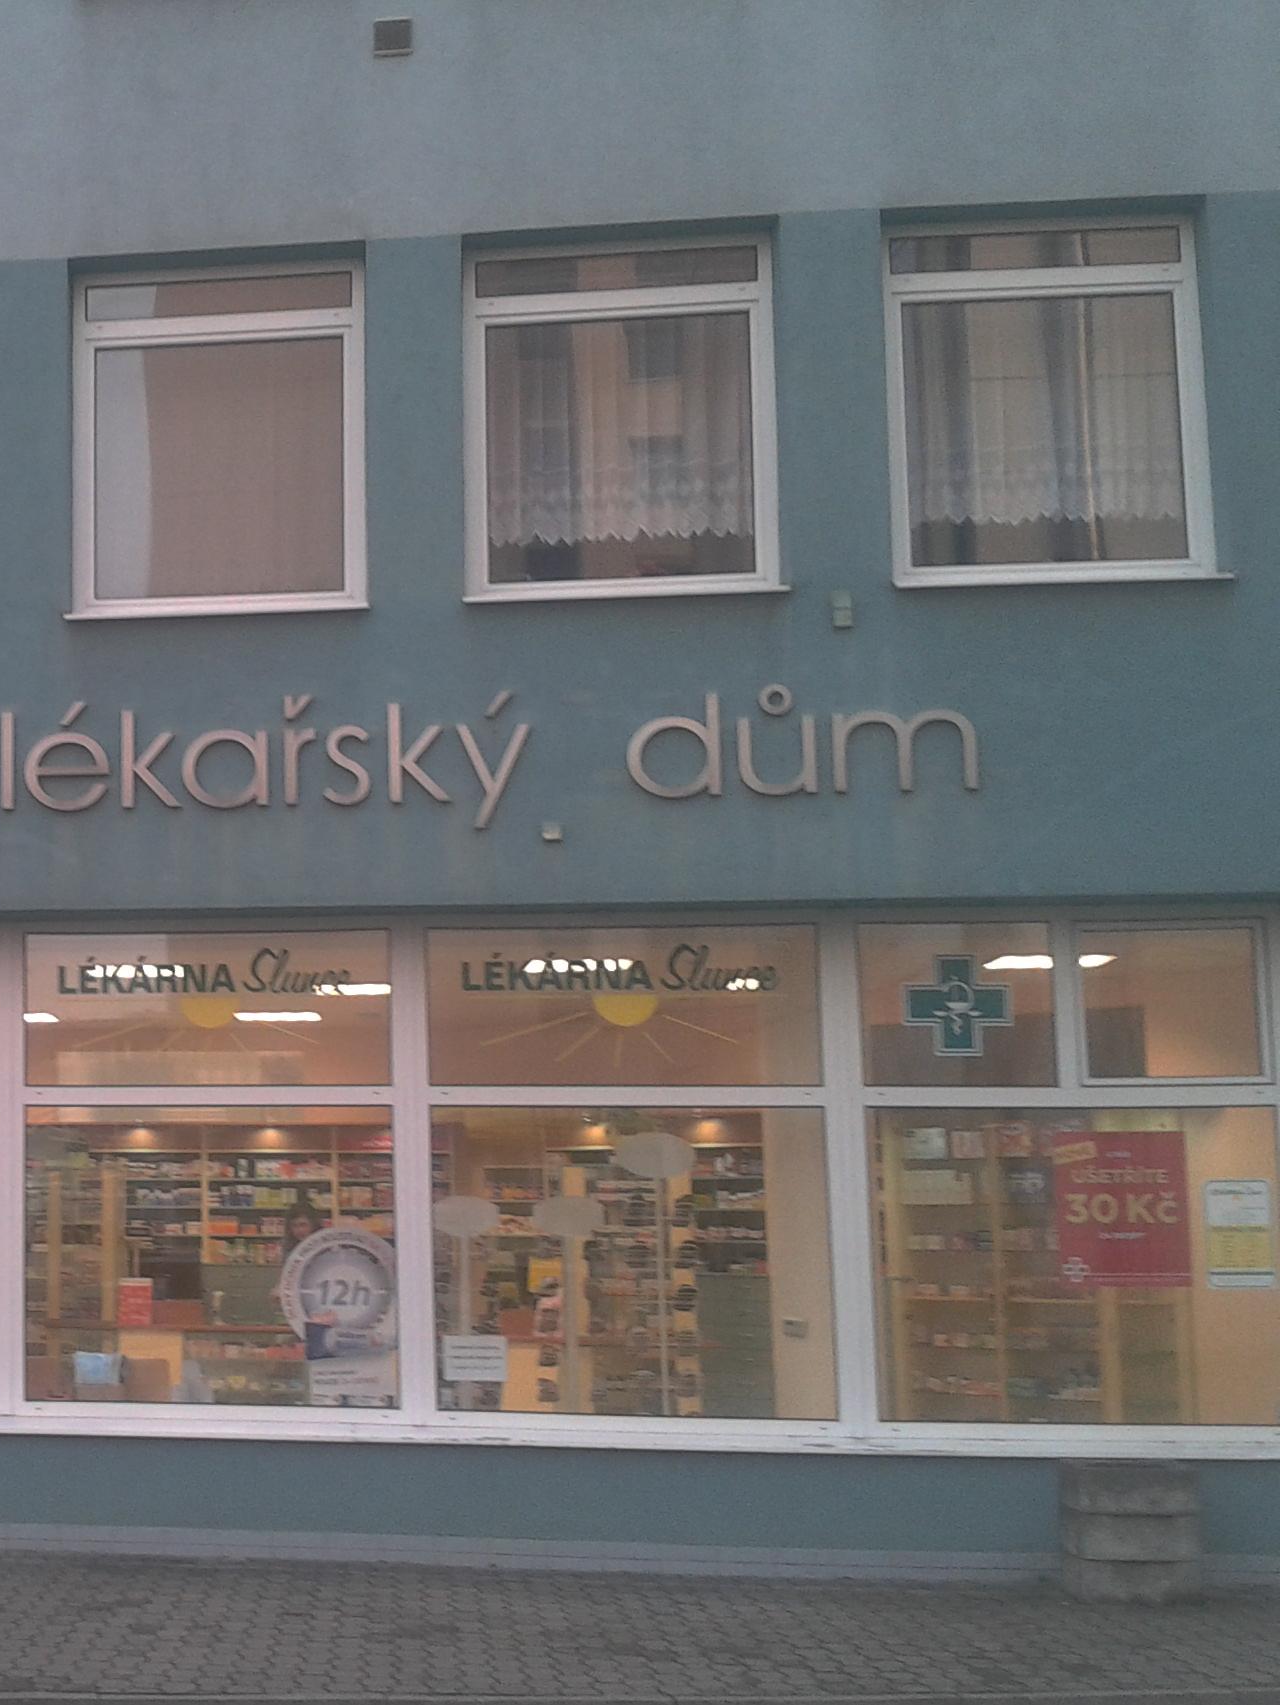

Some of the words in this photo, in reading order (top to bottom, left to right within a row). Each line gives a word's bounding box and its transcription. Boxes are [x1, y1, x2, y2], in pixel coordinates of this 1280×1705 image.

[0, 689, 533, 830] lékařský
[625, 682, 981, 799] dům
[57, 956, 236, 995] LÉKÁRNA
[461, 951, 654, 992] LÉKÁRNA
[1064, 1193, 1119, 1224] 30
[318, 1278, 371, 1306] 12h
